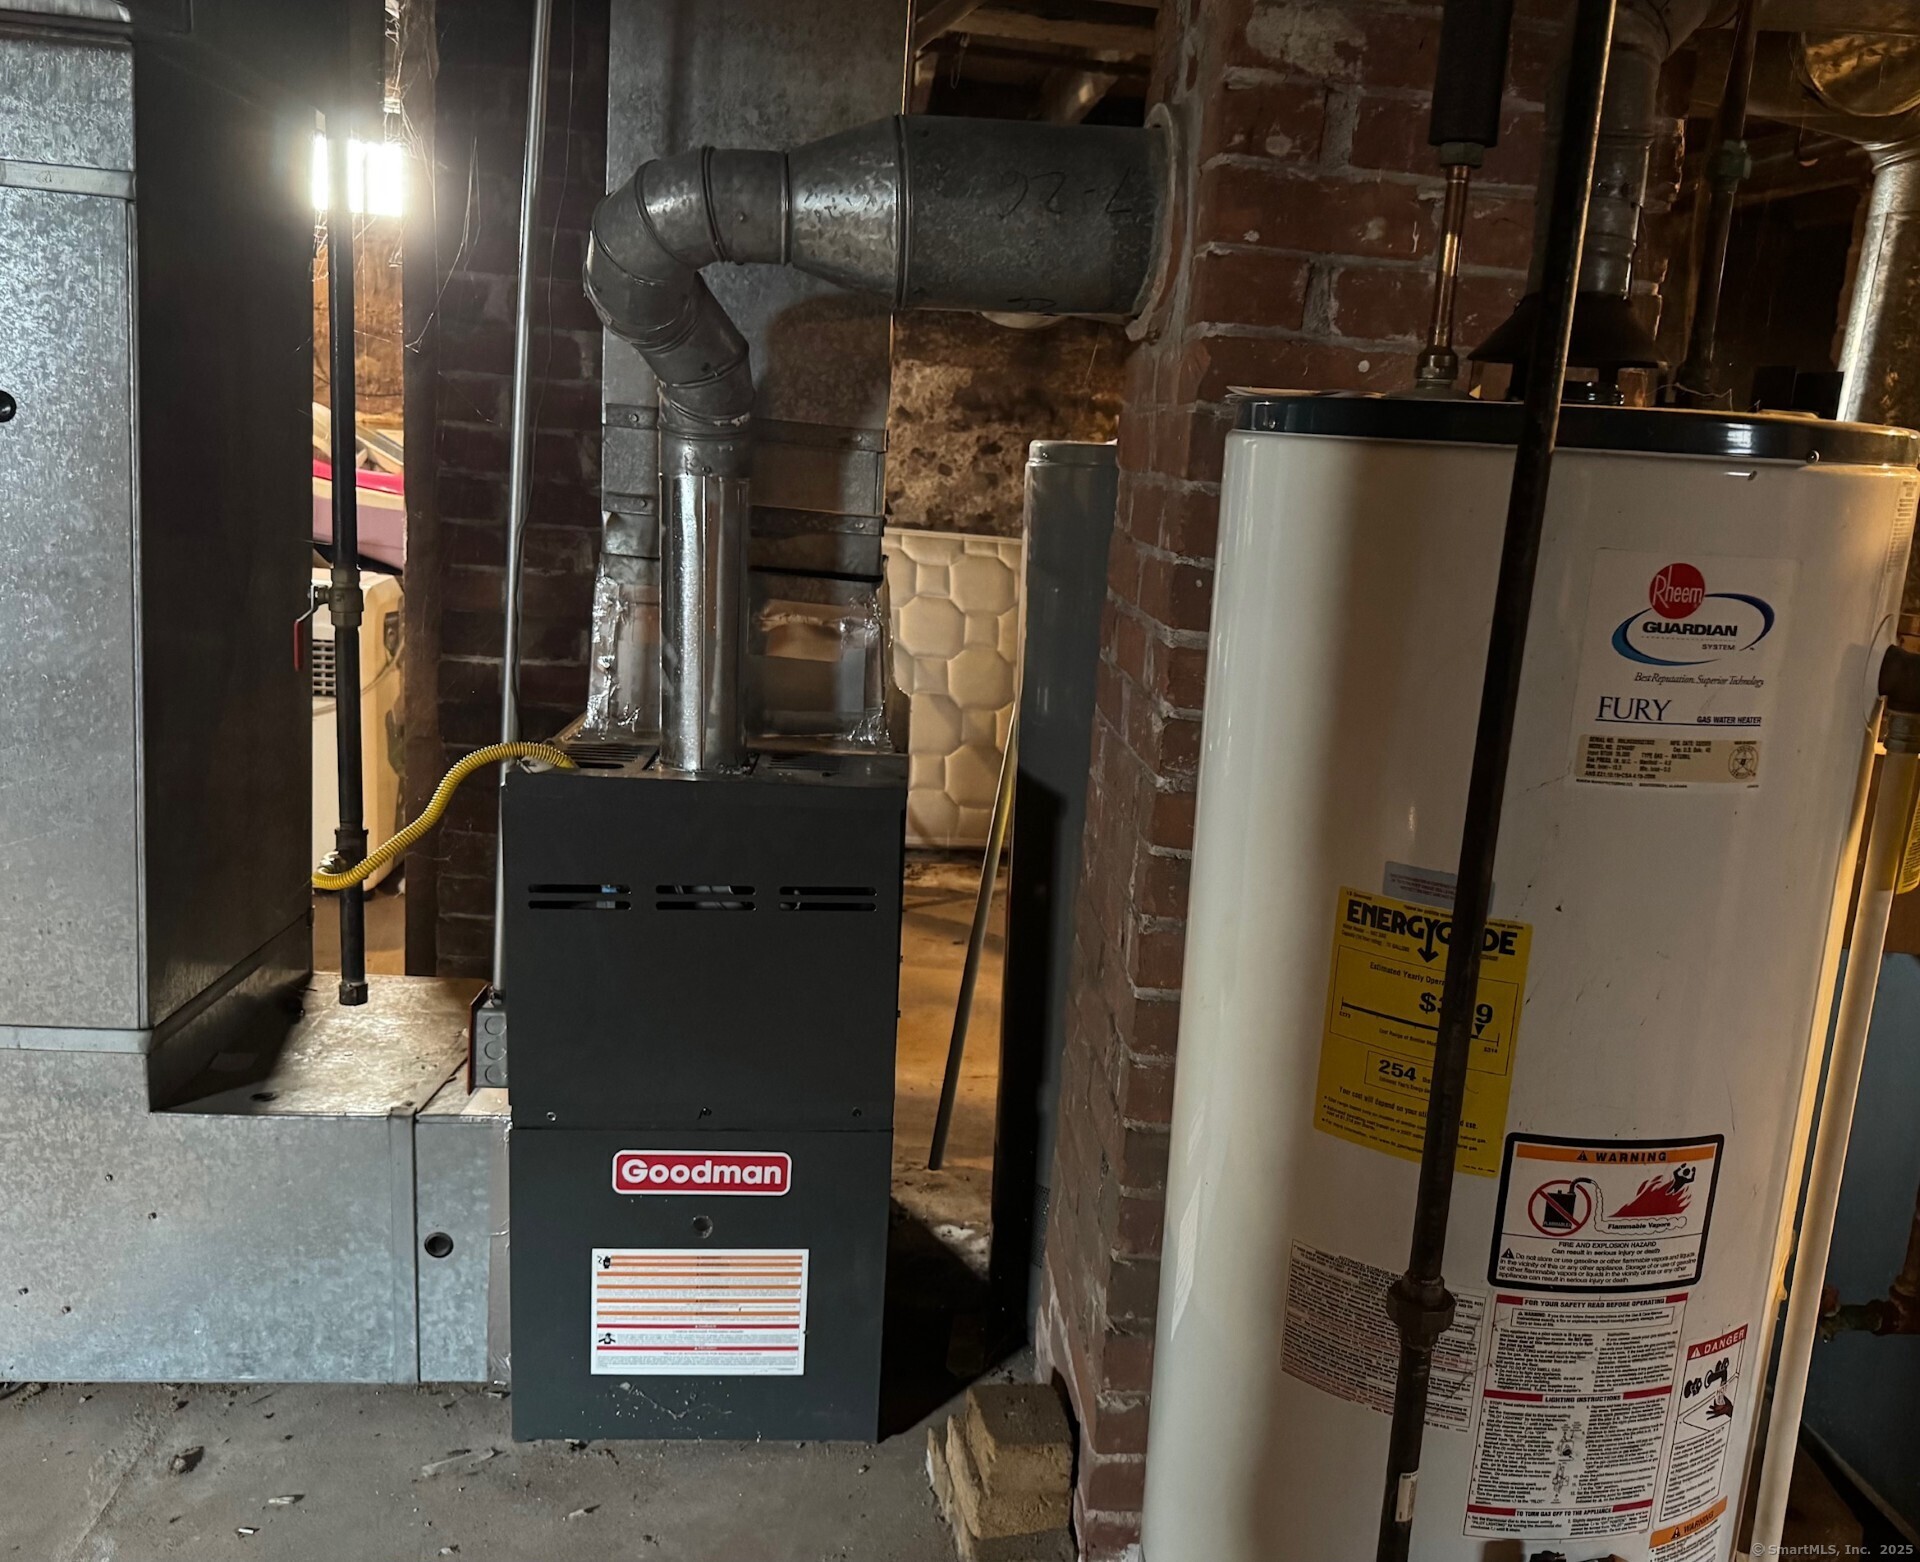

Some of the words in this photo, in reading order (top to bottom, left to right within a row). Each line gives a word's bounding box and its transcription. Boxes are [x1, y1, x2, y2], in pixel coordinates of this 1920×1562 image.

[1652, 565, 1704, 608] Rheem
[1642, 620, 1738, 636] GUARDIAN
[1702, 643, 1736, 651] SYSTEM
[1634, 672, 1652, 682] Best
[1697, 676, 1728, 687] Superior
[1728, 676, 1764, 688] Technology
[1597, 696, 1672, 721] FURY
[1696, 716, 1711, 724] GAS
[1713, 716, 1737, 725] WATER
[1737, 716, 1762, 725] HEATER
[1347, 899, 1517, 956] ENERGYGDE
[1369, 962, 1401, 977] Estimated
[1403, 971, 1425, 983] Yearly
[1378, 1059, 1417, 1081] 254
[1339, 1086, 1351, 1095] Your
[1351, 1091, 1363, 1099] cost
[1364, 1095, 1373, 1104] will
[1374, 1098, 1395, 1111] depend
[1404, 1107, 1417, 1117] your
[1595, 1151, 1666, 1162] WARNING
[622, 1158, 782, 1184] Goodman
[1607, 1222, 1646, 1230] Flammable
[1648, 1222, 1671, 1230] Vapors
[1631, 1298, 1665, 1307] OPERATING
[1704, 1329, 1745, 1354] DANGER
[1583, 1507, 1612, 1515] APPLIANCE
[1683, 1510, 1714, 1534] WARNING
